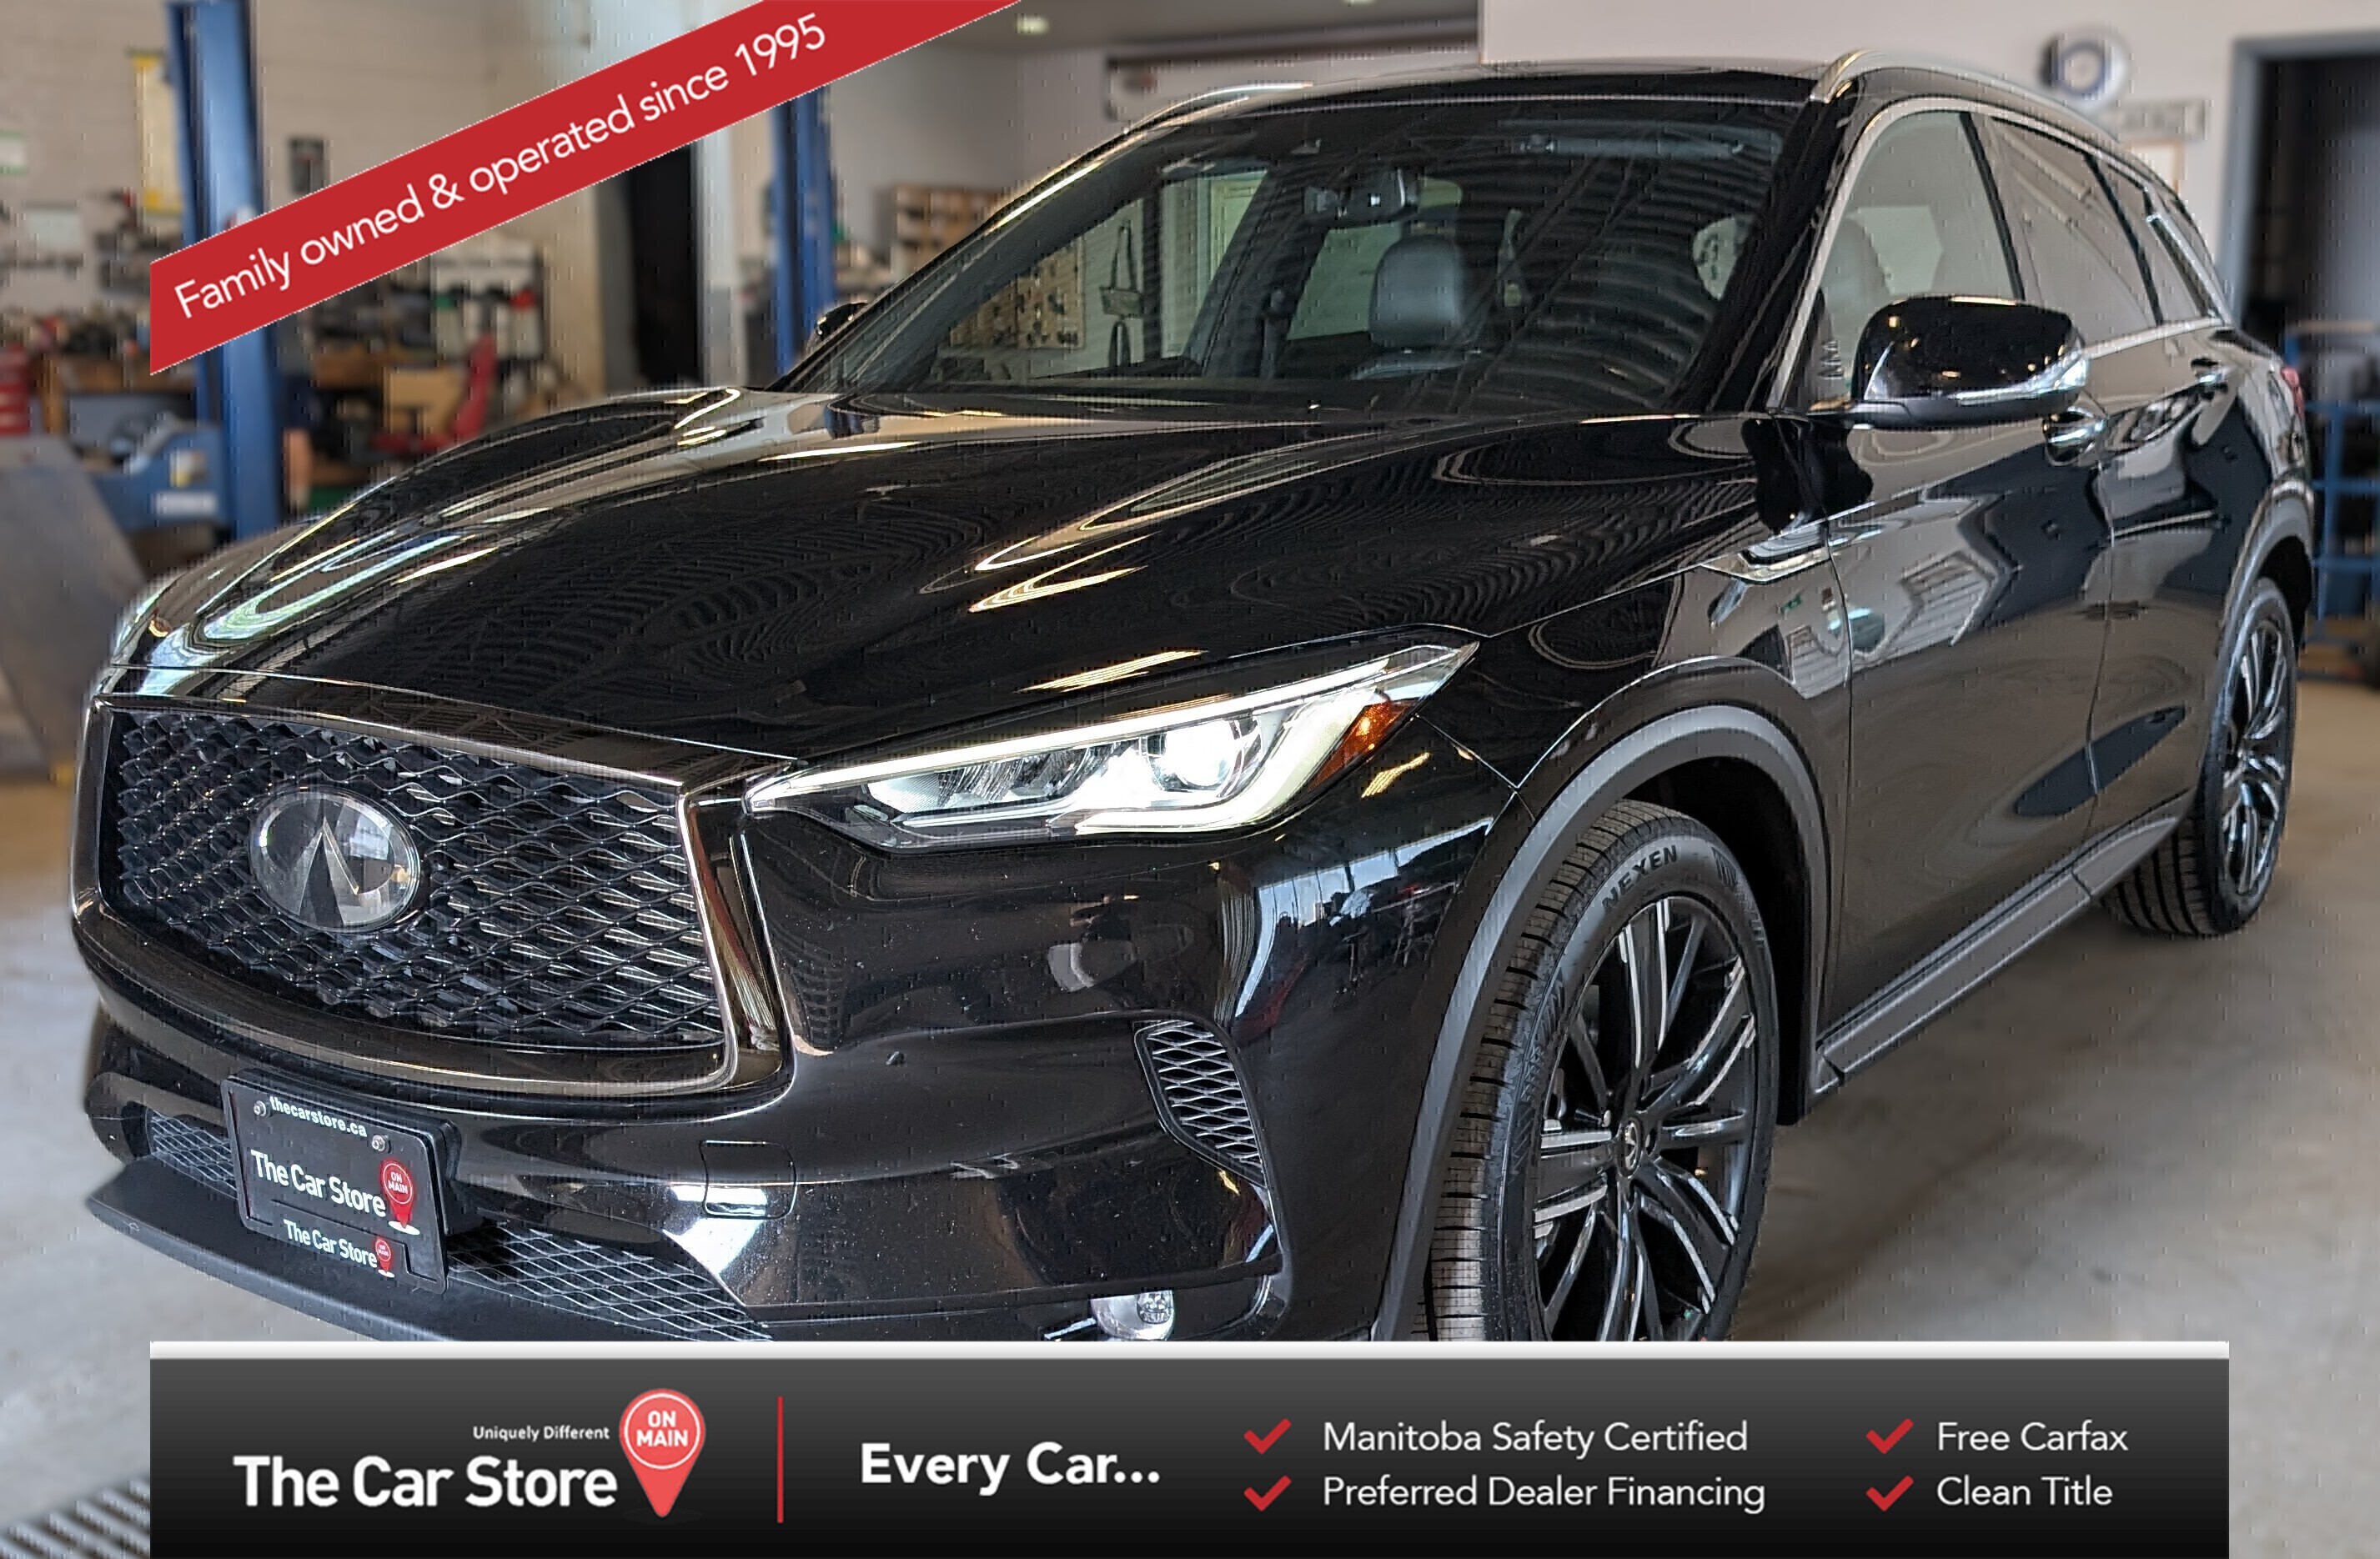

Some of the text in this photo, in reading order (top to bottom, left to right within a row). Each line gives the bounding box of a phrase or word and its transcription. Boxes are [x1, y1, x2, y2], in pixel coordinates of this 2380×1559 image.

[1602, 845, 1677, 909] NEXEN
[269, 1096, 367, 1137] thecarstore.ca
[250, 1150, 386, 1217] The Car Store
[388, 1181, 409, 1195] MAIN
[390, 1171, 403, 1184] ON
[284, 1219, 378, 1267] The Car Store
